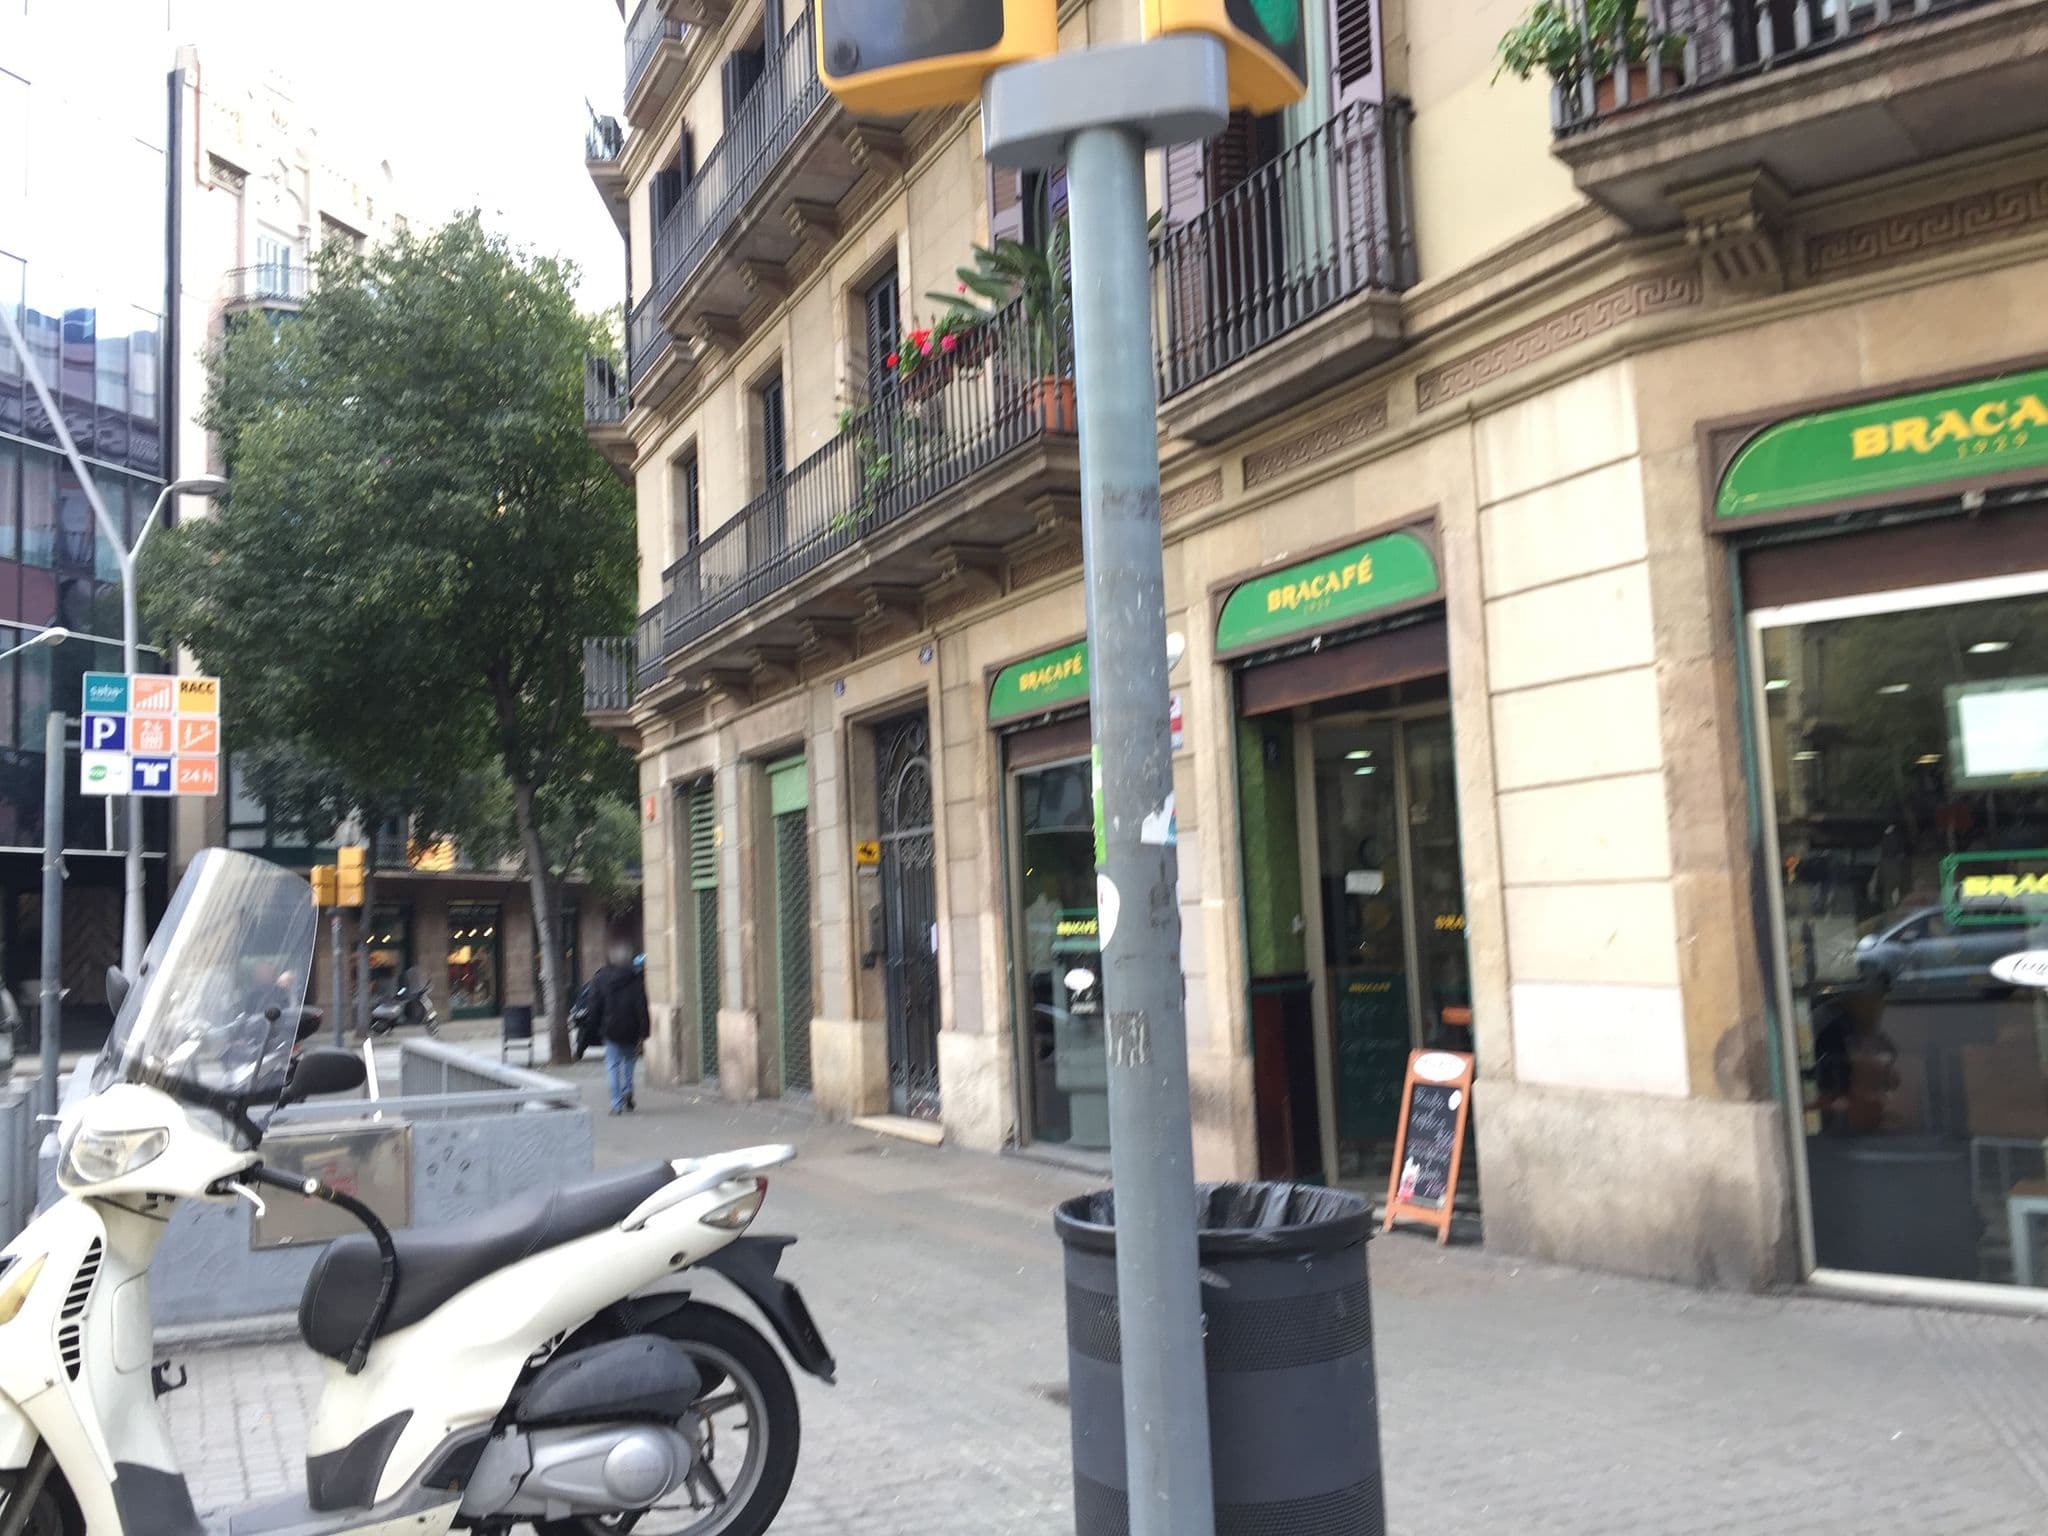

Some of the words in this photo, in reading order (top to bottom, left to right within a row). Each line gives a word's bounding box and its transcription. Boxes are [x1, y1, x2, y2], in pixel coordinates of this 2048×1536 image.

[1853, 395, 2048, 459] BRACA
[1267, 554, 1373, 613] BRACAFÉ
[180, 681, 216, 694] RACC
[1019, 652, 1082, 692] BRACAFÉ
[93, 717, 117, 749] P
